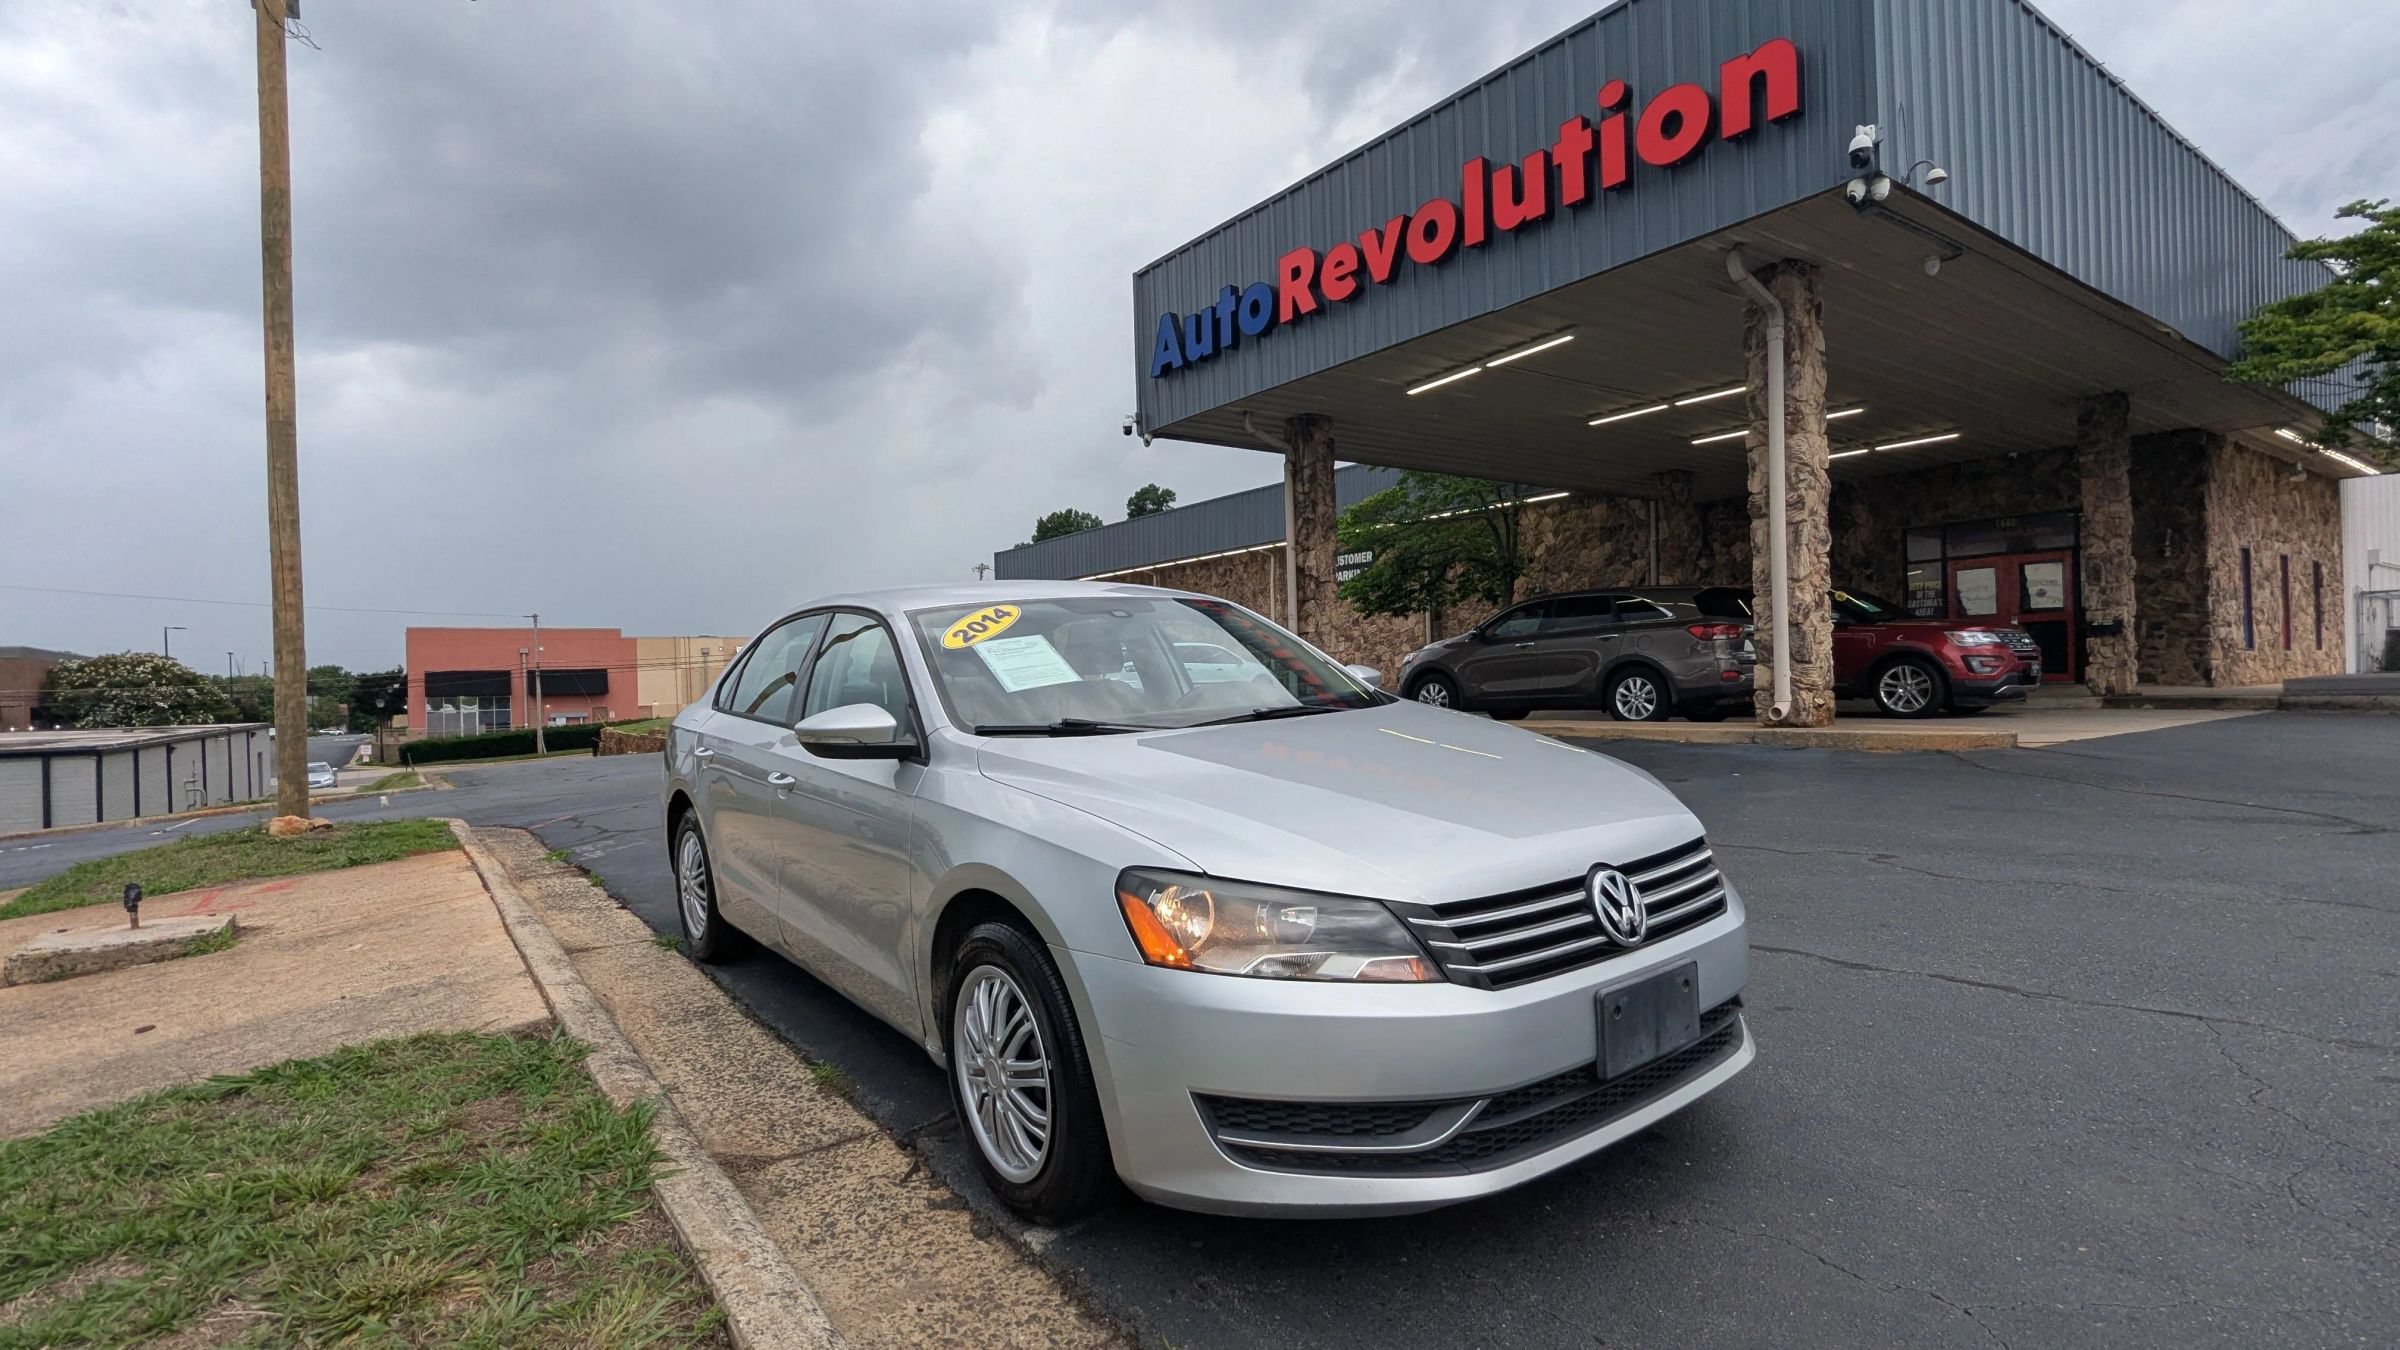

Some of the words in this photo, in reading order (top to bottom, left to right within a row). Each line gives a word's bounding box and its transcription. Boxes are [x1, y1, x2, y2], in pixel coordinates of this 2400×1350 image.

[1335, 551, 1372, 567] USTOMER
[1335, 568, 1368, 582] ARKI
[952, 608, 1013, 643] 2014
